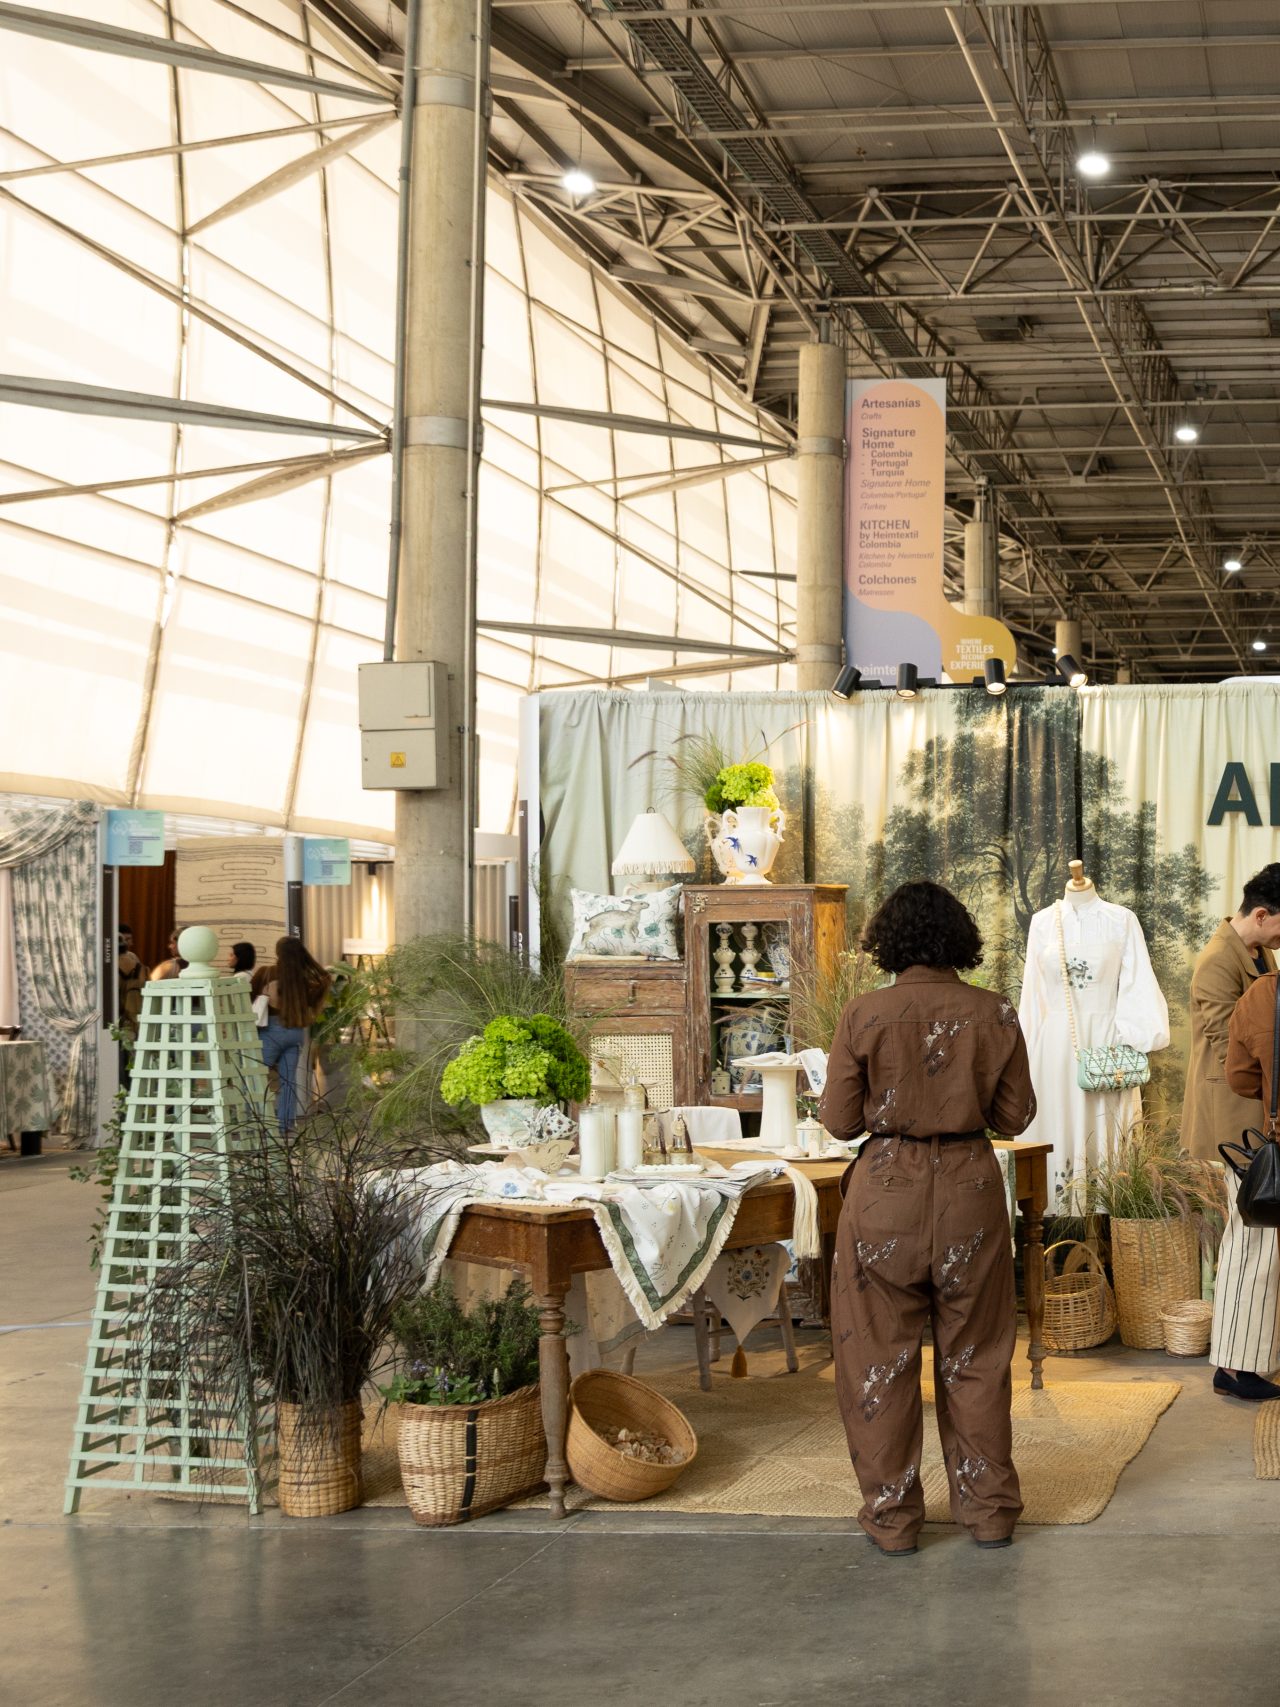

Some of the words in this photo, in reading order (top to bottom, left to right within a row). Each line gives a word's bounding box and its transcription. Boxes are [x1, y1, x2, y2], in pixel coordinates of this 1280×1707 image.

[861, 398, 921, 409] Artesanías
[862, 427, 916, 440] Signature
[862, 439, 895, 449] Home
[871, 450, 913, 458] Colombia
[871, 459, 909, 469] Portugal
[861, 480, 903, 489] Signature
[904, 479, 932, 487] Home
[860, 520, 911, 530] KITCHEN
[860, 531, 870, 540] by
[873, 530, 919, 539] Heimtextil
[859, 541, 901, 549] Colombia
[859, 574, 917, 584] Colchones
[956, 644, 994, 654] TEXTILES
